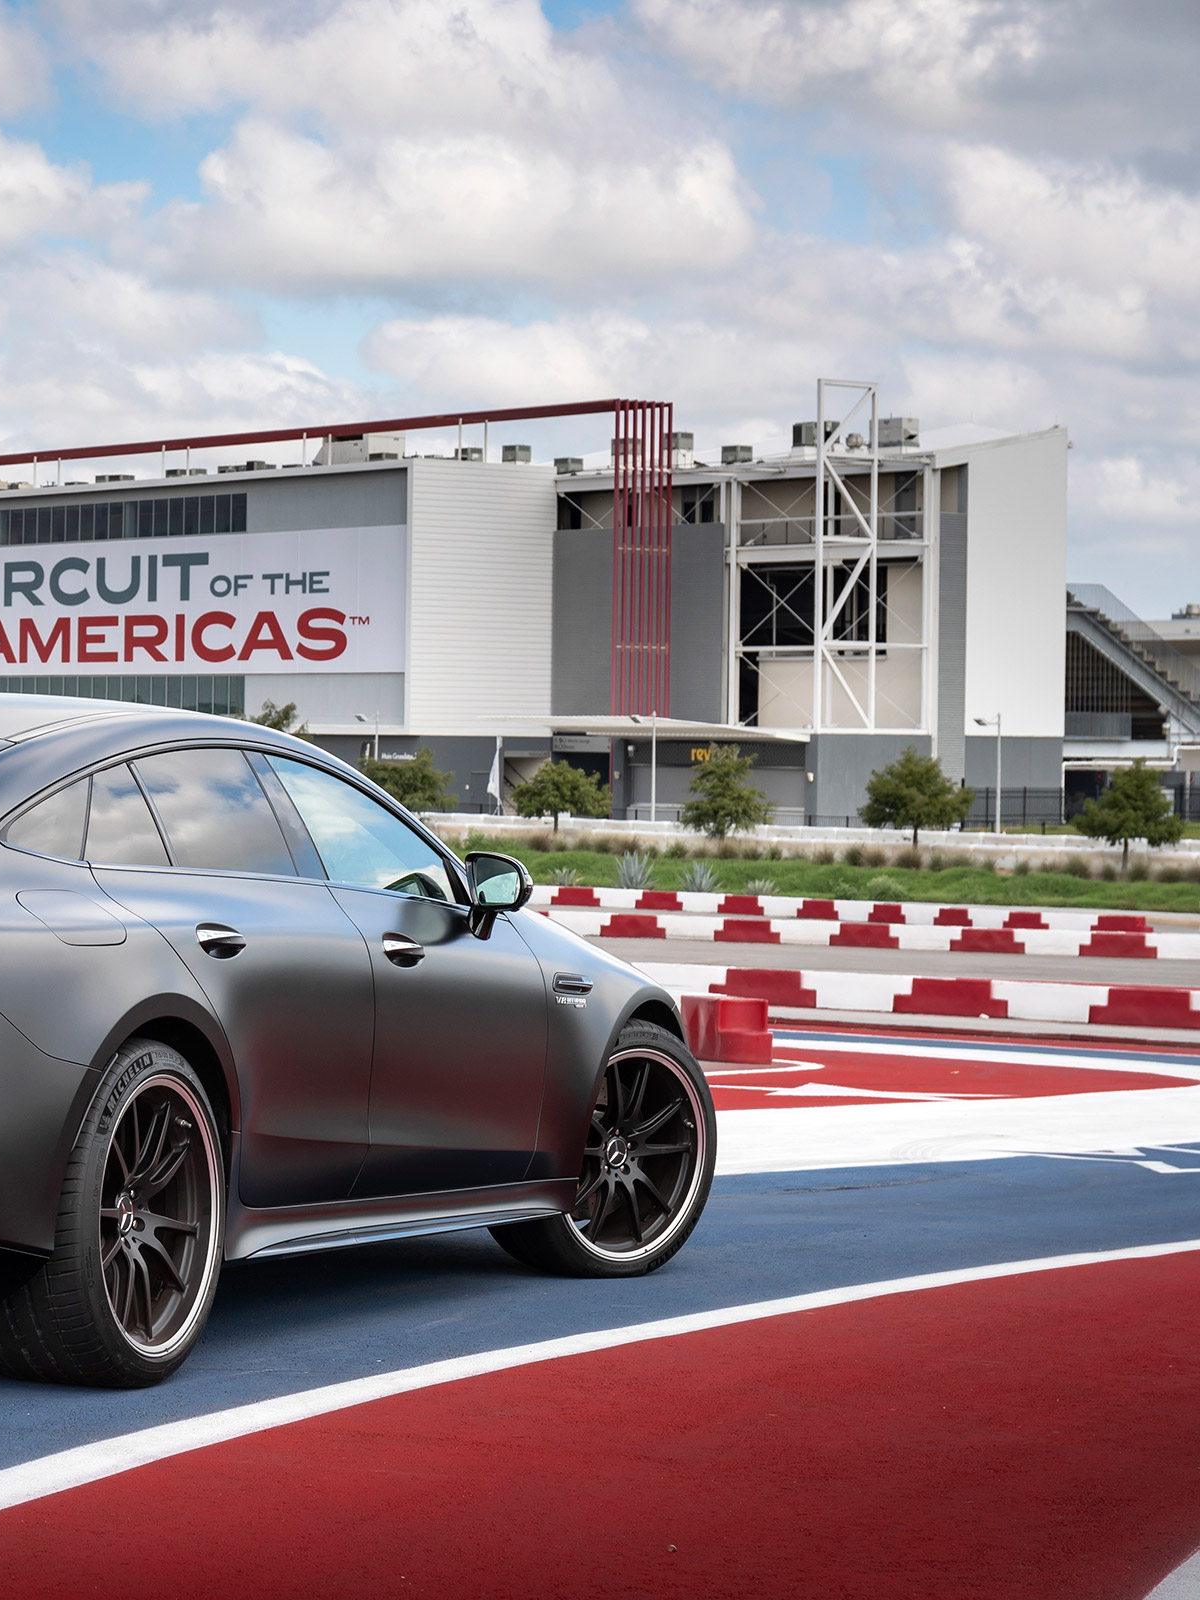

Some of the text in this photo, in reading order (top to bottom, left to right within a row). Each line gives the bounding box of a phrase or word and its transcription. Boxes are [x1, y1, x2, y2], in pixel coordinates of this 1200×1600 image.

[209, 574, 253, 598] OF
[262, 571, 330, 595] THE
[106, 1053, 153, 1113] MICHELIN
